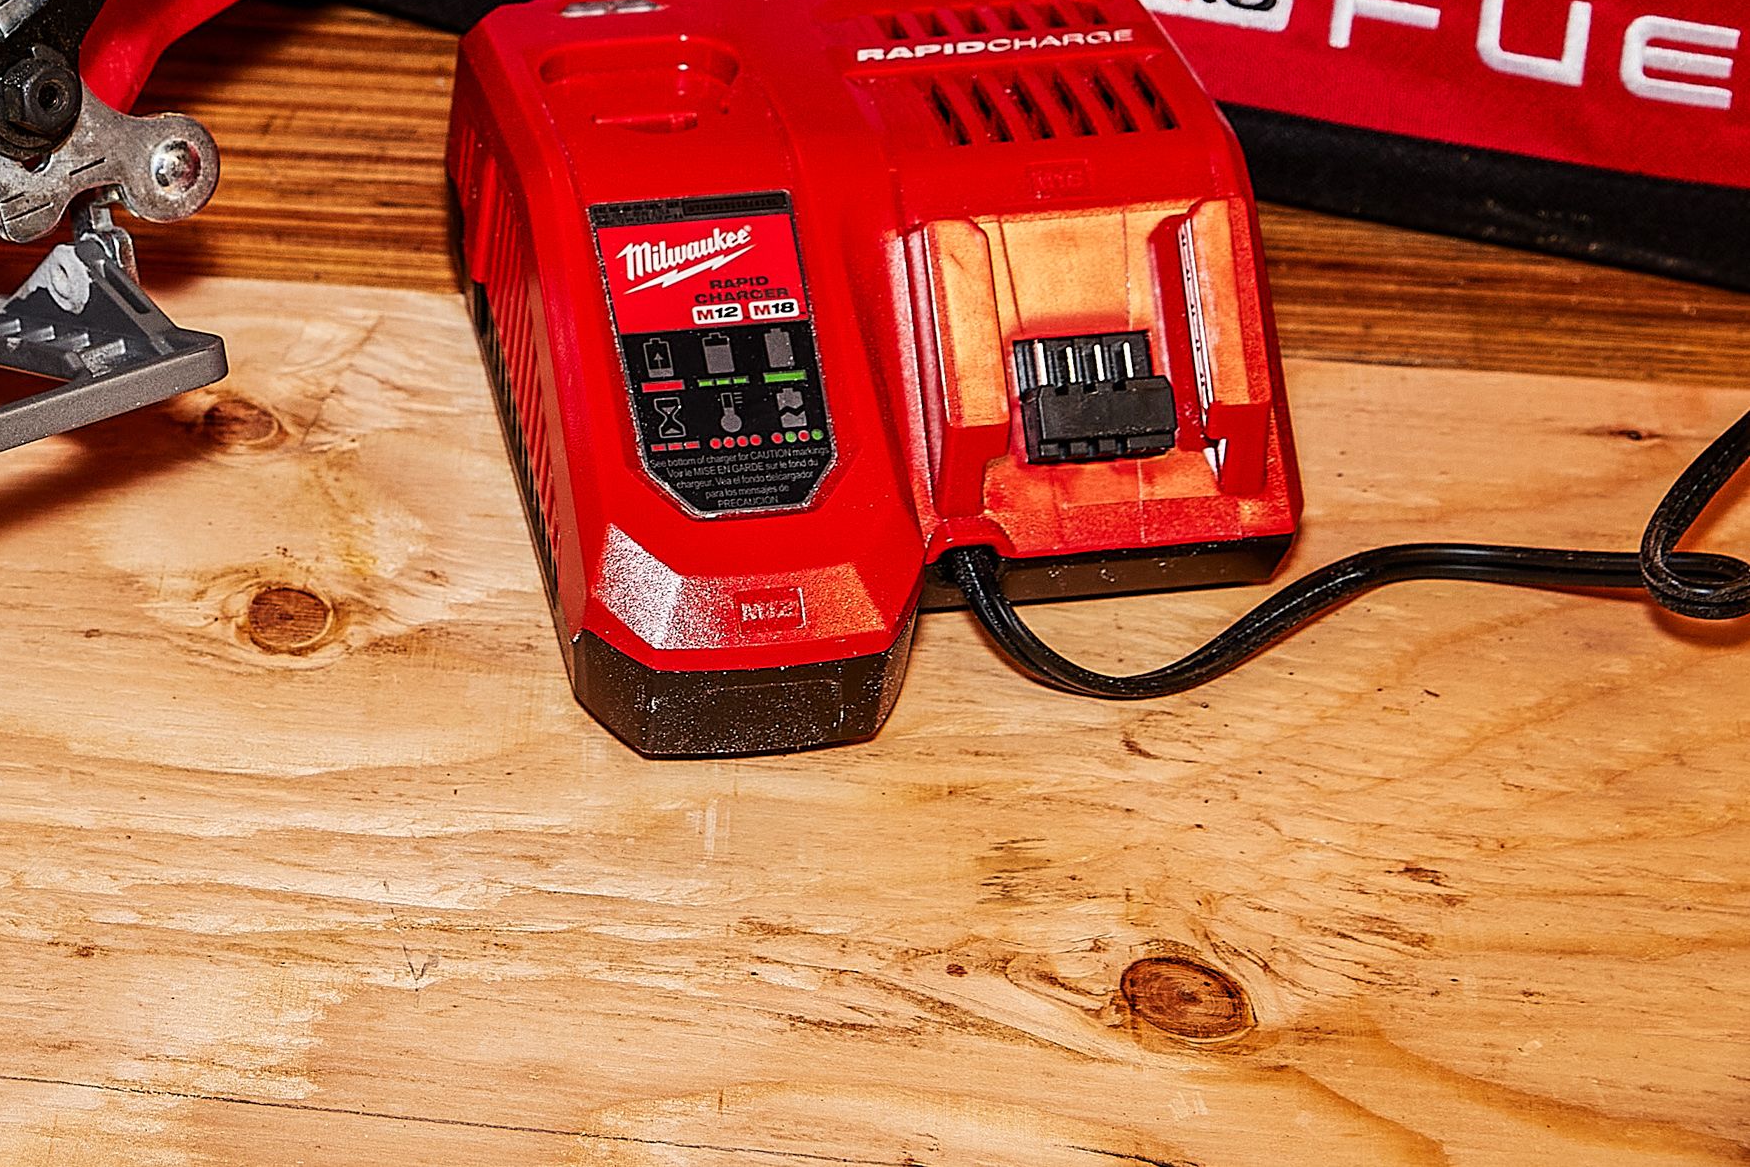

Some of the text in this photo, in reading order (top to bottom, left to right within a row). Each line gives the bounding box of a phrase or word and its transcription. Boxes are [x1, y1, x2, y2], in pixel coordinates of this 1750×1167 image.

[615, 227, 752, 281] Milwaukee
[709, 275, 769, 290] RAPID
[694, 287, 790, 304] CHARGER
[696, 302, 795, 322] M12 M18
[667, 457, 696, 467] bottom
[706, 454, 737, 465] charger
[750, 448, 791, 460] CAUTION
[694, 465, 716, 475] MISE
[732, 462, 764, 473] GARDE
